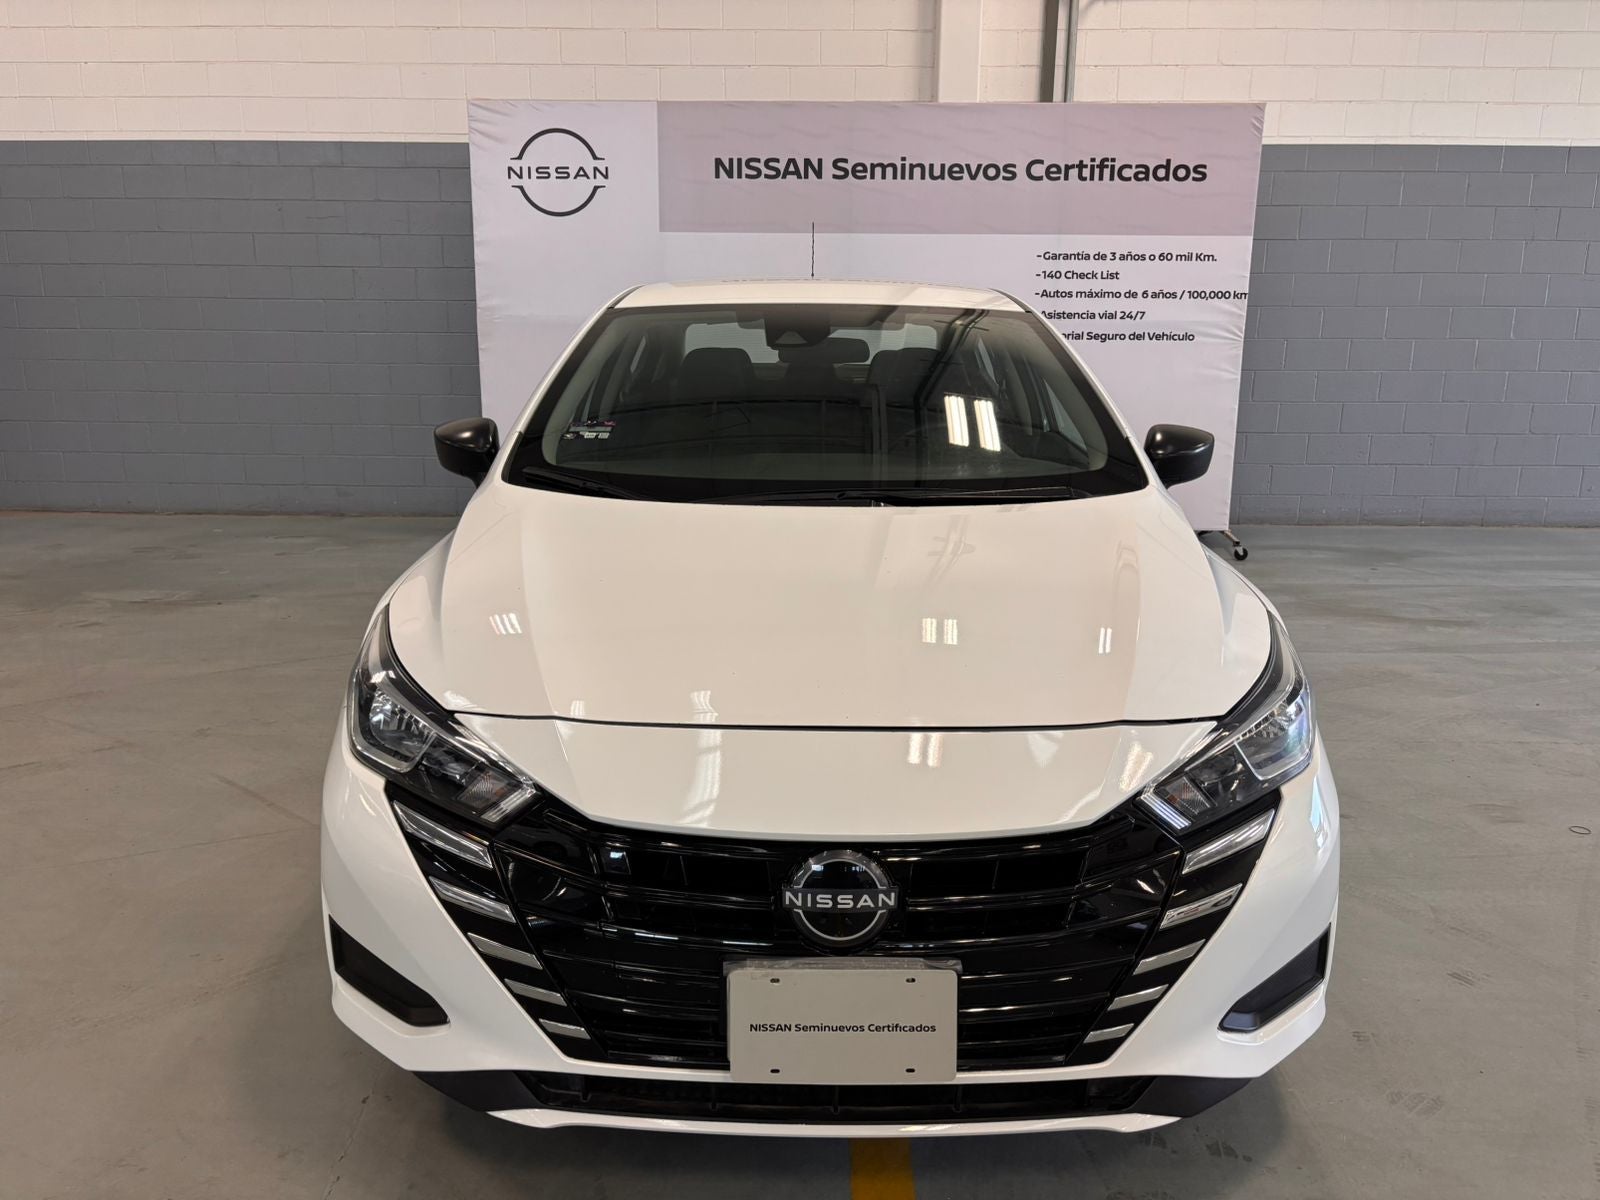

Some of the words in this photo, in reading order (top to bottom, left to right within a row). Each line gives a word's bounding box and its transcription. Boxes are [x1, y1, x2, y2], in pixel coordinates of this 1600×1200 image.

[507, 165, 610, 180] NISSAN
[714, 156, 823, 180] NISSAN
[831, 156, 1018, 182] Seminuevos
[1025, 156, 1208, 183] Certificados
[1036, 250, 1091, 262] -Garantía
[1092, 251, 1108, 262] de
[1109, 251, 1117, 262] 3
[1118, 251, 1147, 262] años
[1148, 253, 1157, 262] o
[1158, 252, 1174, 262] 60
[1175, 251, 1194, 262] mil
[1194, 252, 1218, 263] Km.
[1035, 270, 1063, 280] -140
[1063, 269, 1099, 280] Check
[1099, 269, 1120, 280] List
[1034, 288, 1074, 299] -Autos
[1075, 288, 1122, 299] máximo
[1123, 289, 1139, 299] de
[1141, 289, 1150, 299] 6
[1150, 289, 1178, 300] años
[1178, 289, 1186, 301] /
[1187, 290, 1232, 301] 100,000
[1097, 310, 1118, 320] vial
[1119, 310, 1146, 321] 24/7
[1085, 331, 1127, 343] Seguro
[1127, 331, 1146, 342] del
[1146, 331, 1196, 342] Vehículo
[784, 890, 896, 909] NISSAN
[749, 1023, 792, 1033] NISSAN
[794, 1022, 866, 1033] Seminuevos
[867, 1022, 937, 1033] Certificados
